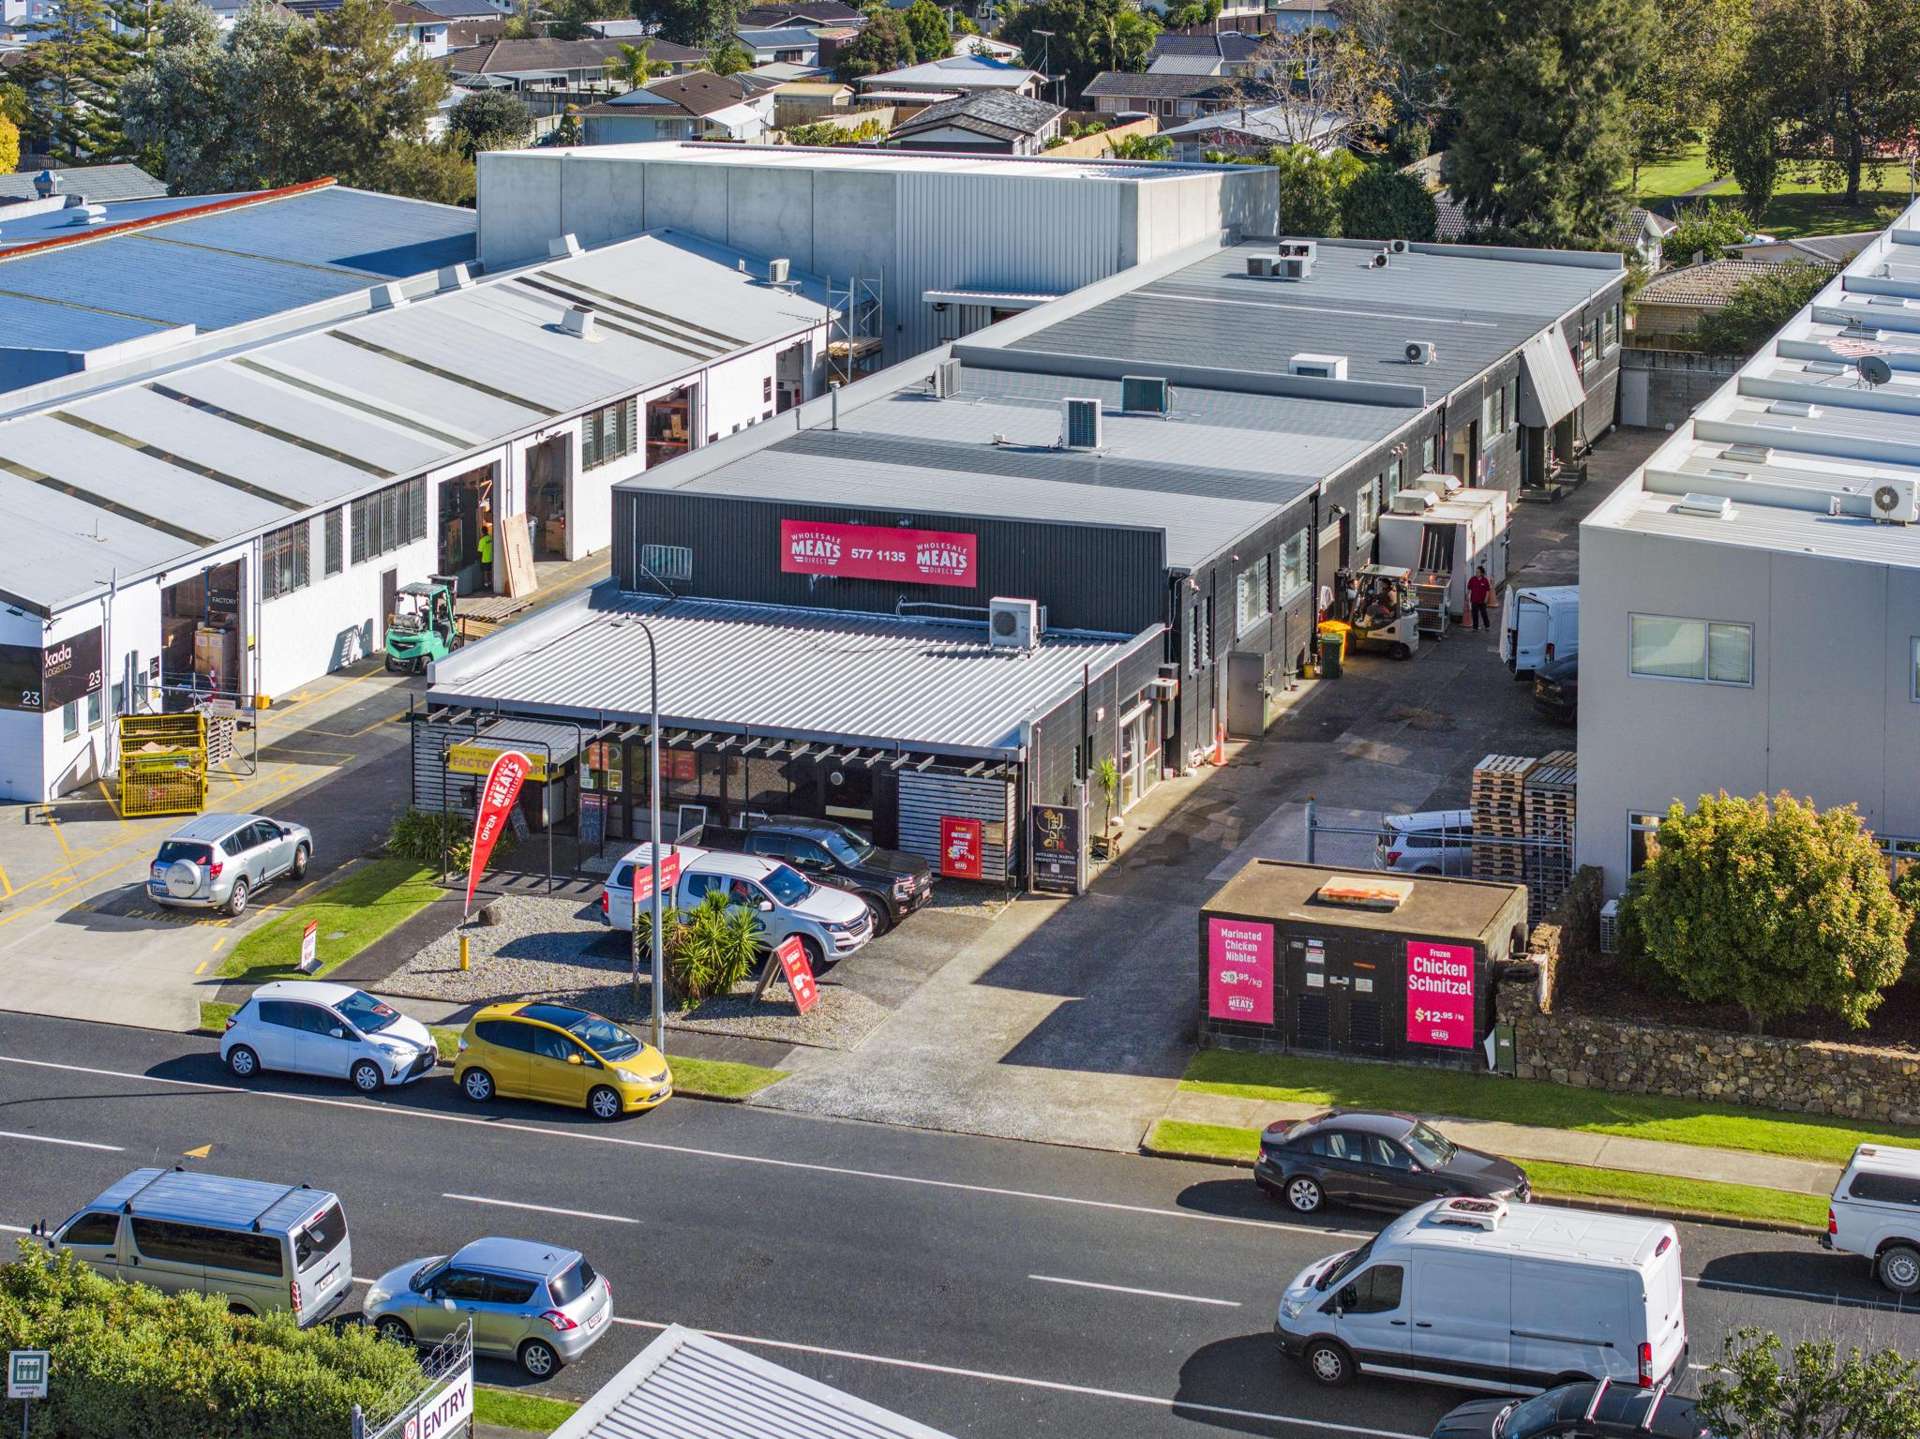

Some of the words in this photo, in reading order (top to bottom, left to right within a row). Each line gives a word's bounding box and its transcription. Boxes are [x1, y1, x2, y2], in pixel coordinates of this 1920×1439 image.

[791, 532, 841, 544] WHOLESALE
[791, 541, 841, 558] MEATS
[851, 548, 873, 560] 577
[876, 550, 906, 562] 1135
[916, 543, 968, 554] WHOLESALE
[803, 556, 828, 566] DIRECT
[916, 551, 968, 569] MEATS
[928, 566, 954, 576] DIRECT
[88, 670, 101, 687] 23
[22, 690, 40, 706] 23
[492, 763, 521, 808] MEATS
[481, 815, 498, 841] OPEN
[1221, 928, 1262, 942] Marinated
[1225, 940, 1257, 952] Chicken
[1226, 951, 1257, 963] Nibbles
[1429, 949, 1451, 959] Frozen
[1413, 957, 1467, 977] Chicken
[1408, 974, 1472, 996] Schnitzel
[1228, 998, 1254, 1009] MEATS
[424, 1381, 468, 1439] ENTRY
